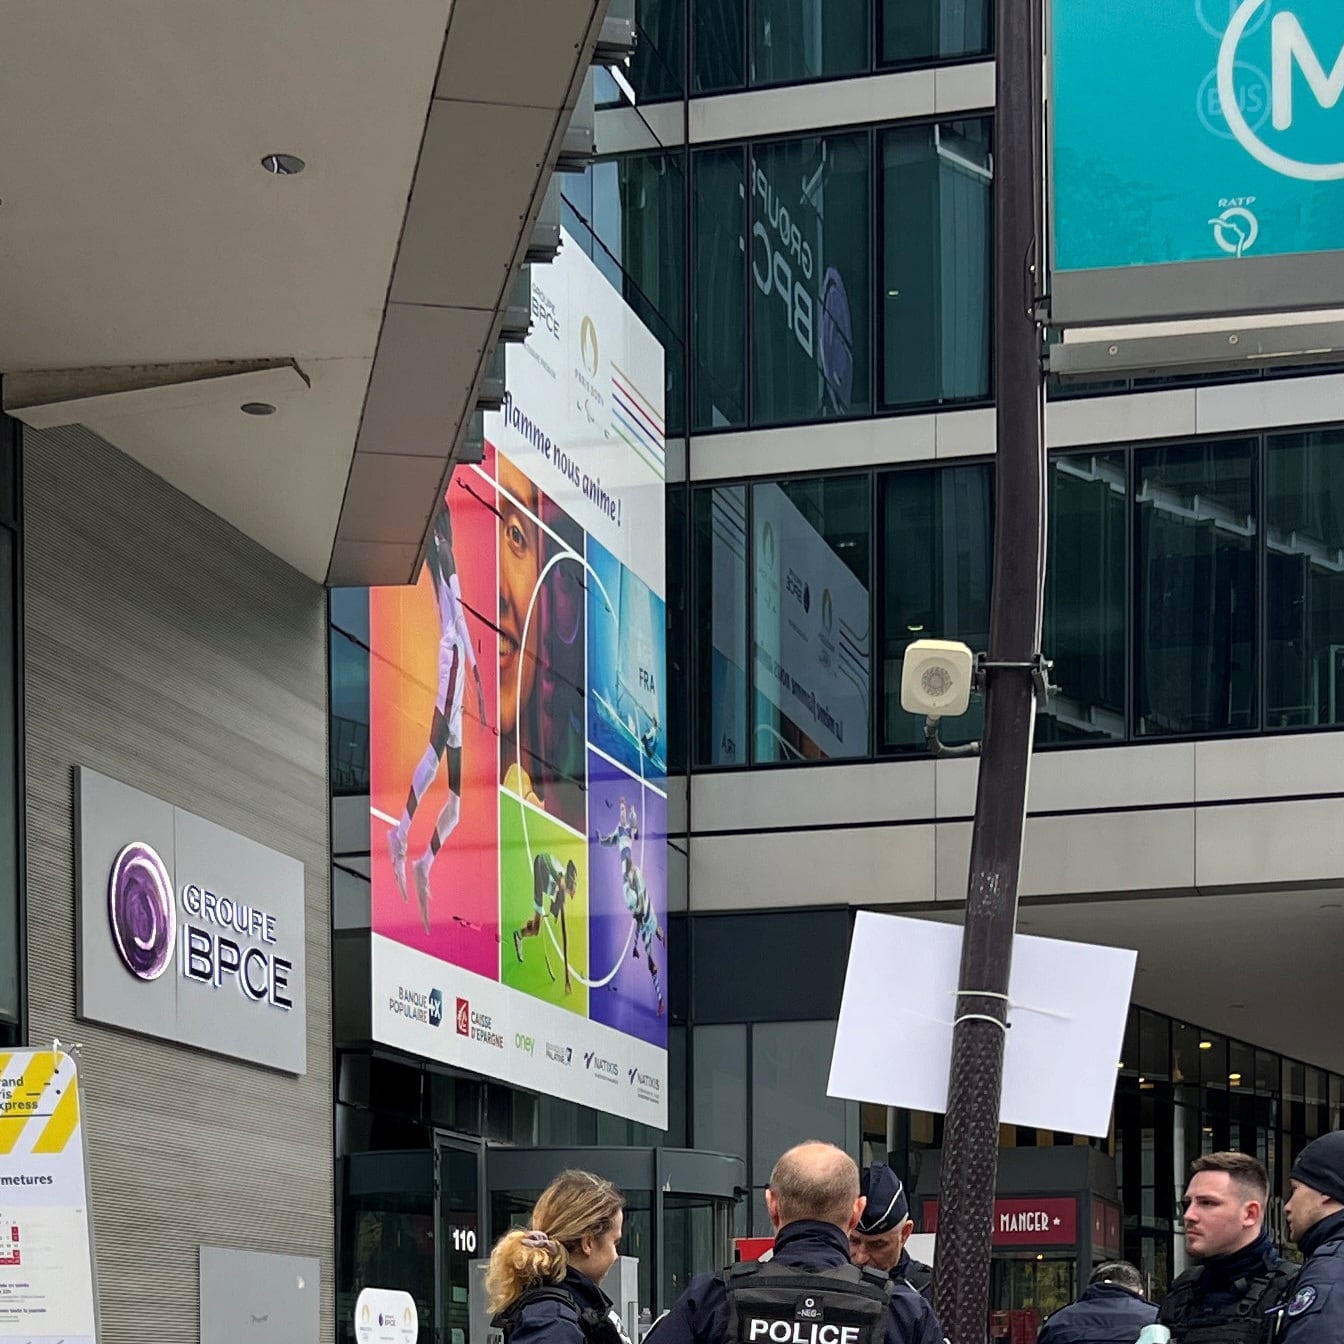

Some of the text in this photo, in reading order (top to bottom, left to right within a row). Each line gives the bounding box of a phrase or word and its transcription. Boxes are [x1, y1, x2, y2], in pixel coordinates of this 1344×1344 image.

[1218, 196, 1256, 208] RATP
[552, 445, 582, 488] nous
[583, 472, 616, 520] anime
[639, 667, 655, 695] FRA
[182, 882, 278, 945] GROUPE
[180, 922, 294, 1011] BPCE
[399, 986, 428, 1009] BANQUE
[389, 998, 428, 1024] POPULAIRE
[471, 1011, 492, 1030] CAISSE
[515, 1032, 535, 1057] oney
[594, 1057, 619, 1076] NATIXIS
[1000, 1211, 1049, 1232] MANGER
[452, 1229, 476, 1252] 110
